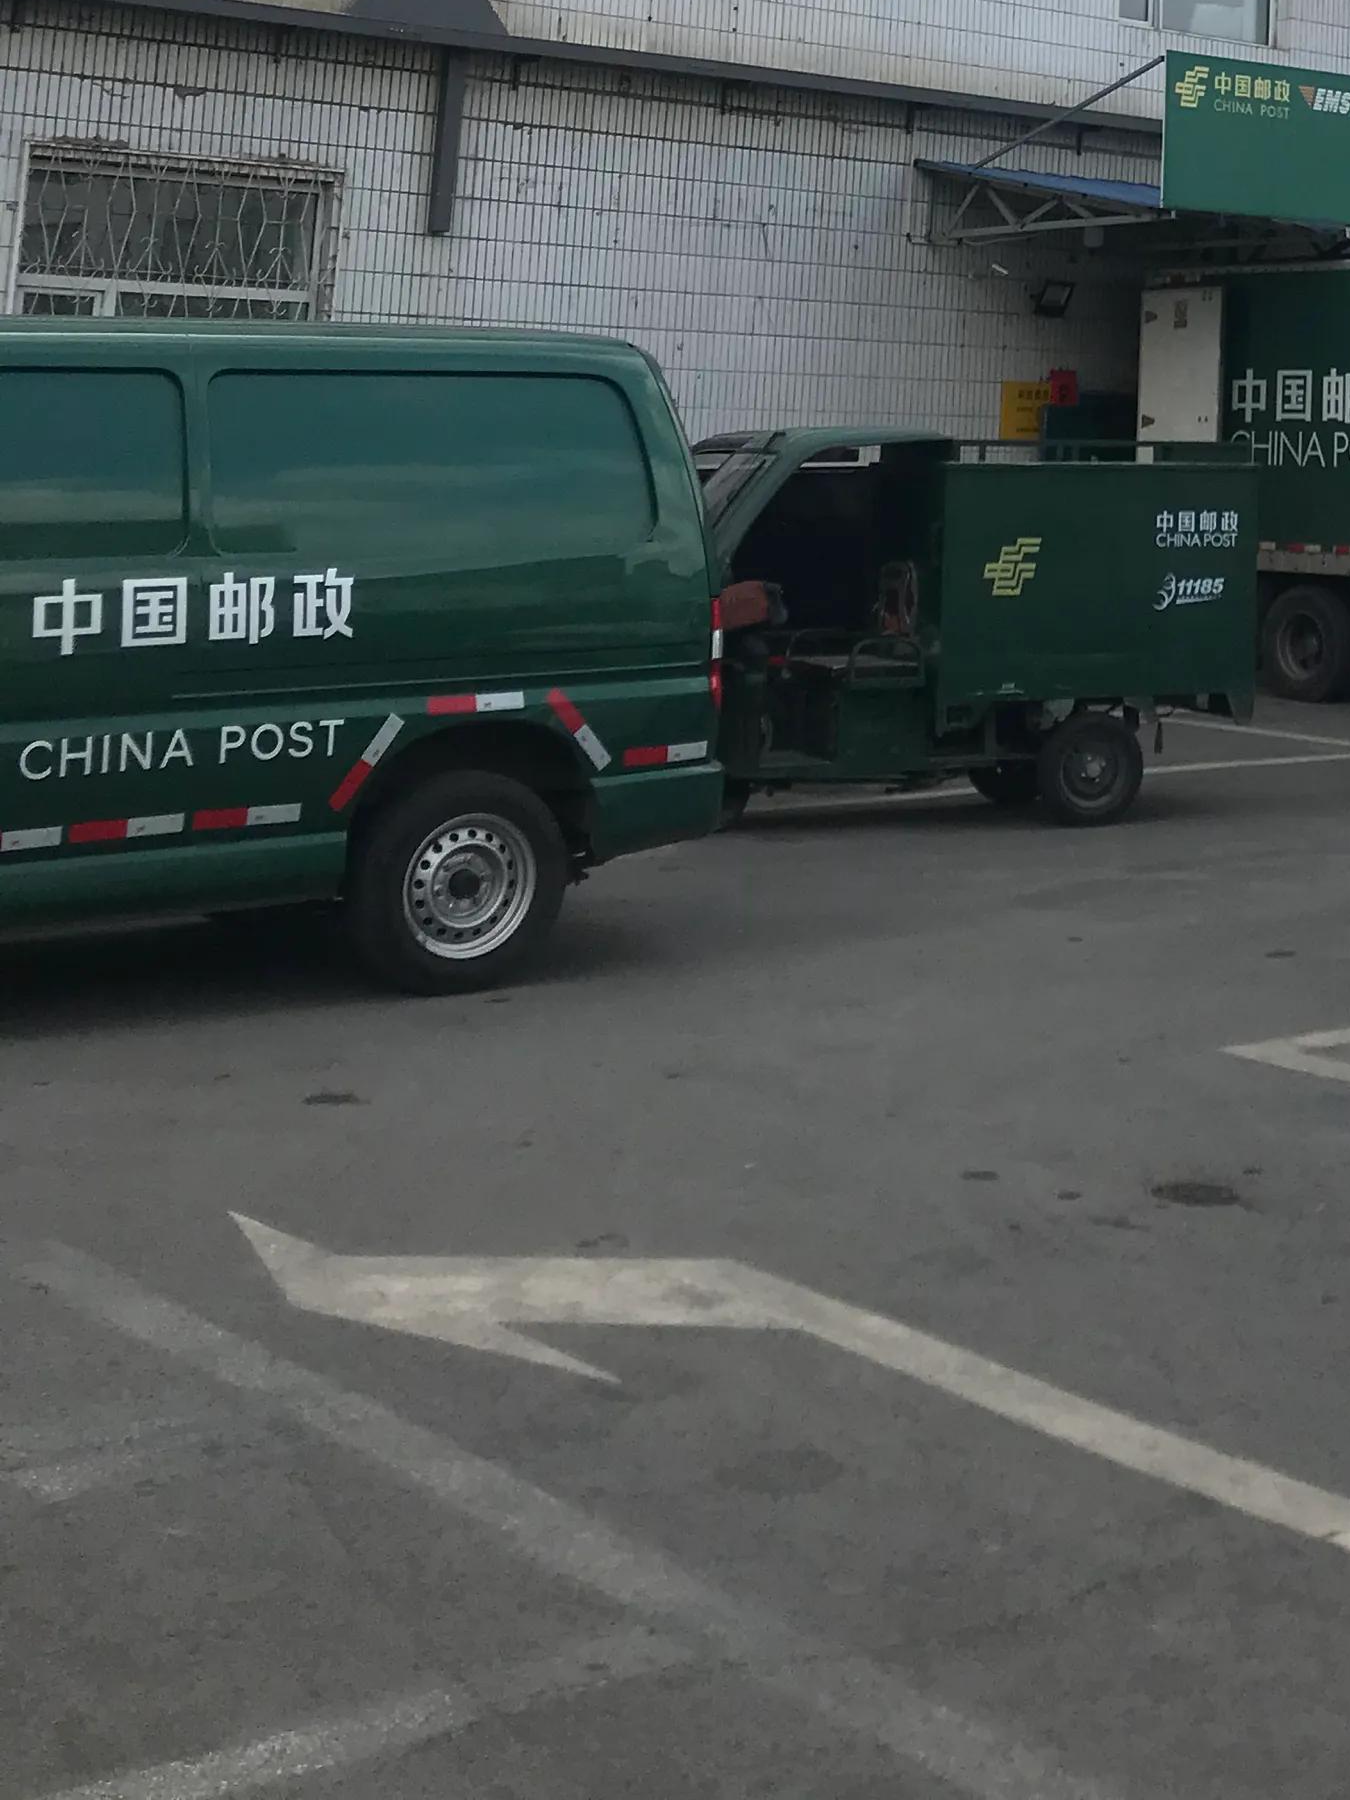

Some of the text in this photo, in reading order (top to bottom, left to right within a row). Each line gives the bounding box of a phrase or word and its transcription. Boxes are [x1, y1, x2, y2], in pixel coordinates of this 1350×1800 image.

[1214, 71, 1290, 103] 中国邮政
[1213, 98, 1290, 120] CHINA POST
[1156, 509, 1239, 533] 中国邮政
[1155, 533, 1238, 548] CHINA POST
[1177, 578, 1225, 596] 11185
[32, 567, 356, 656] 中国邮政
[19, 718, 346, 781] CHINA POST
